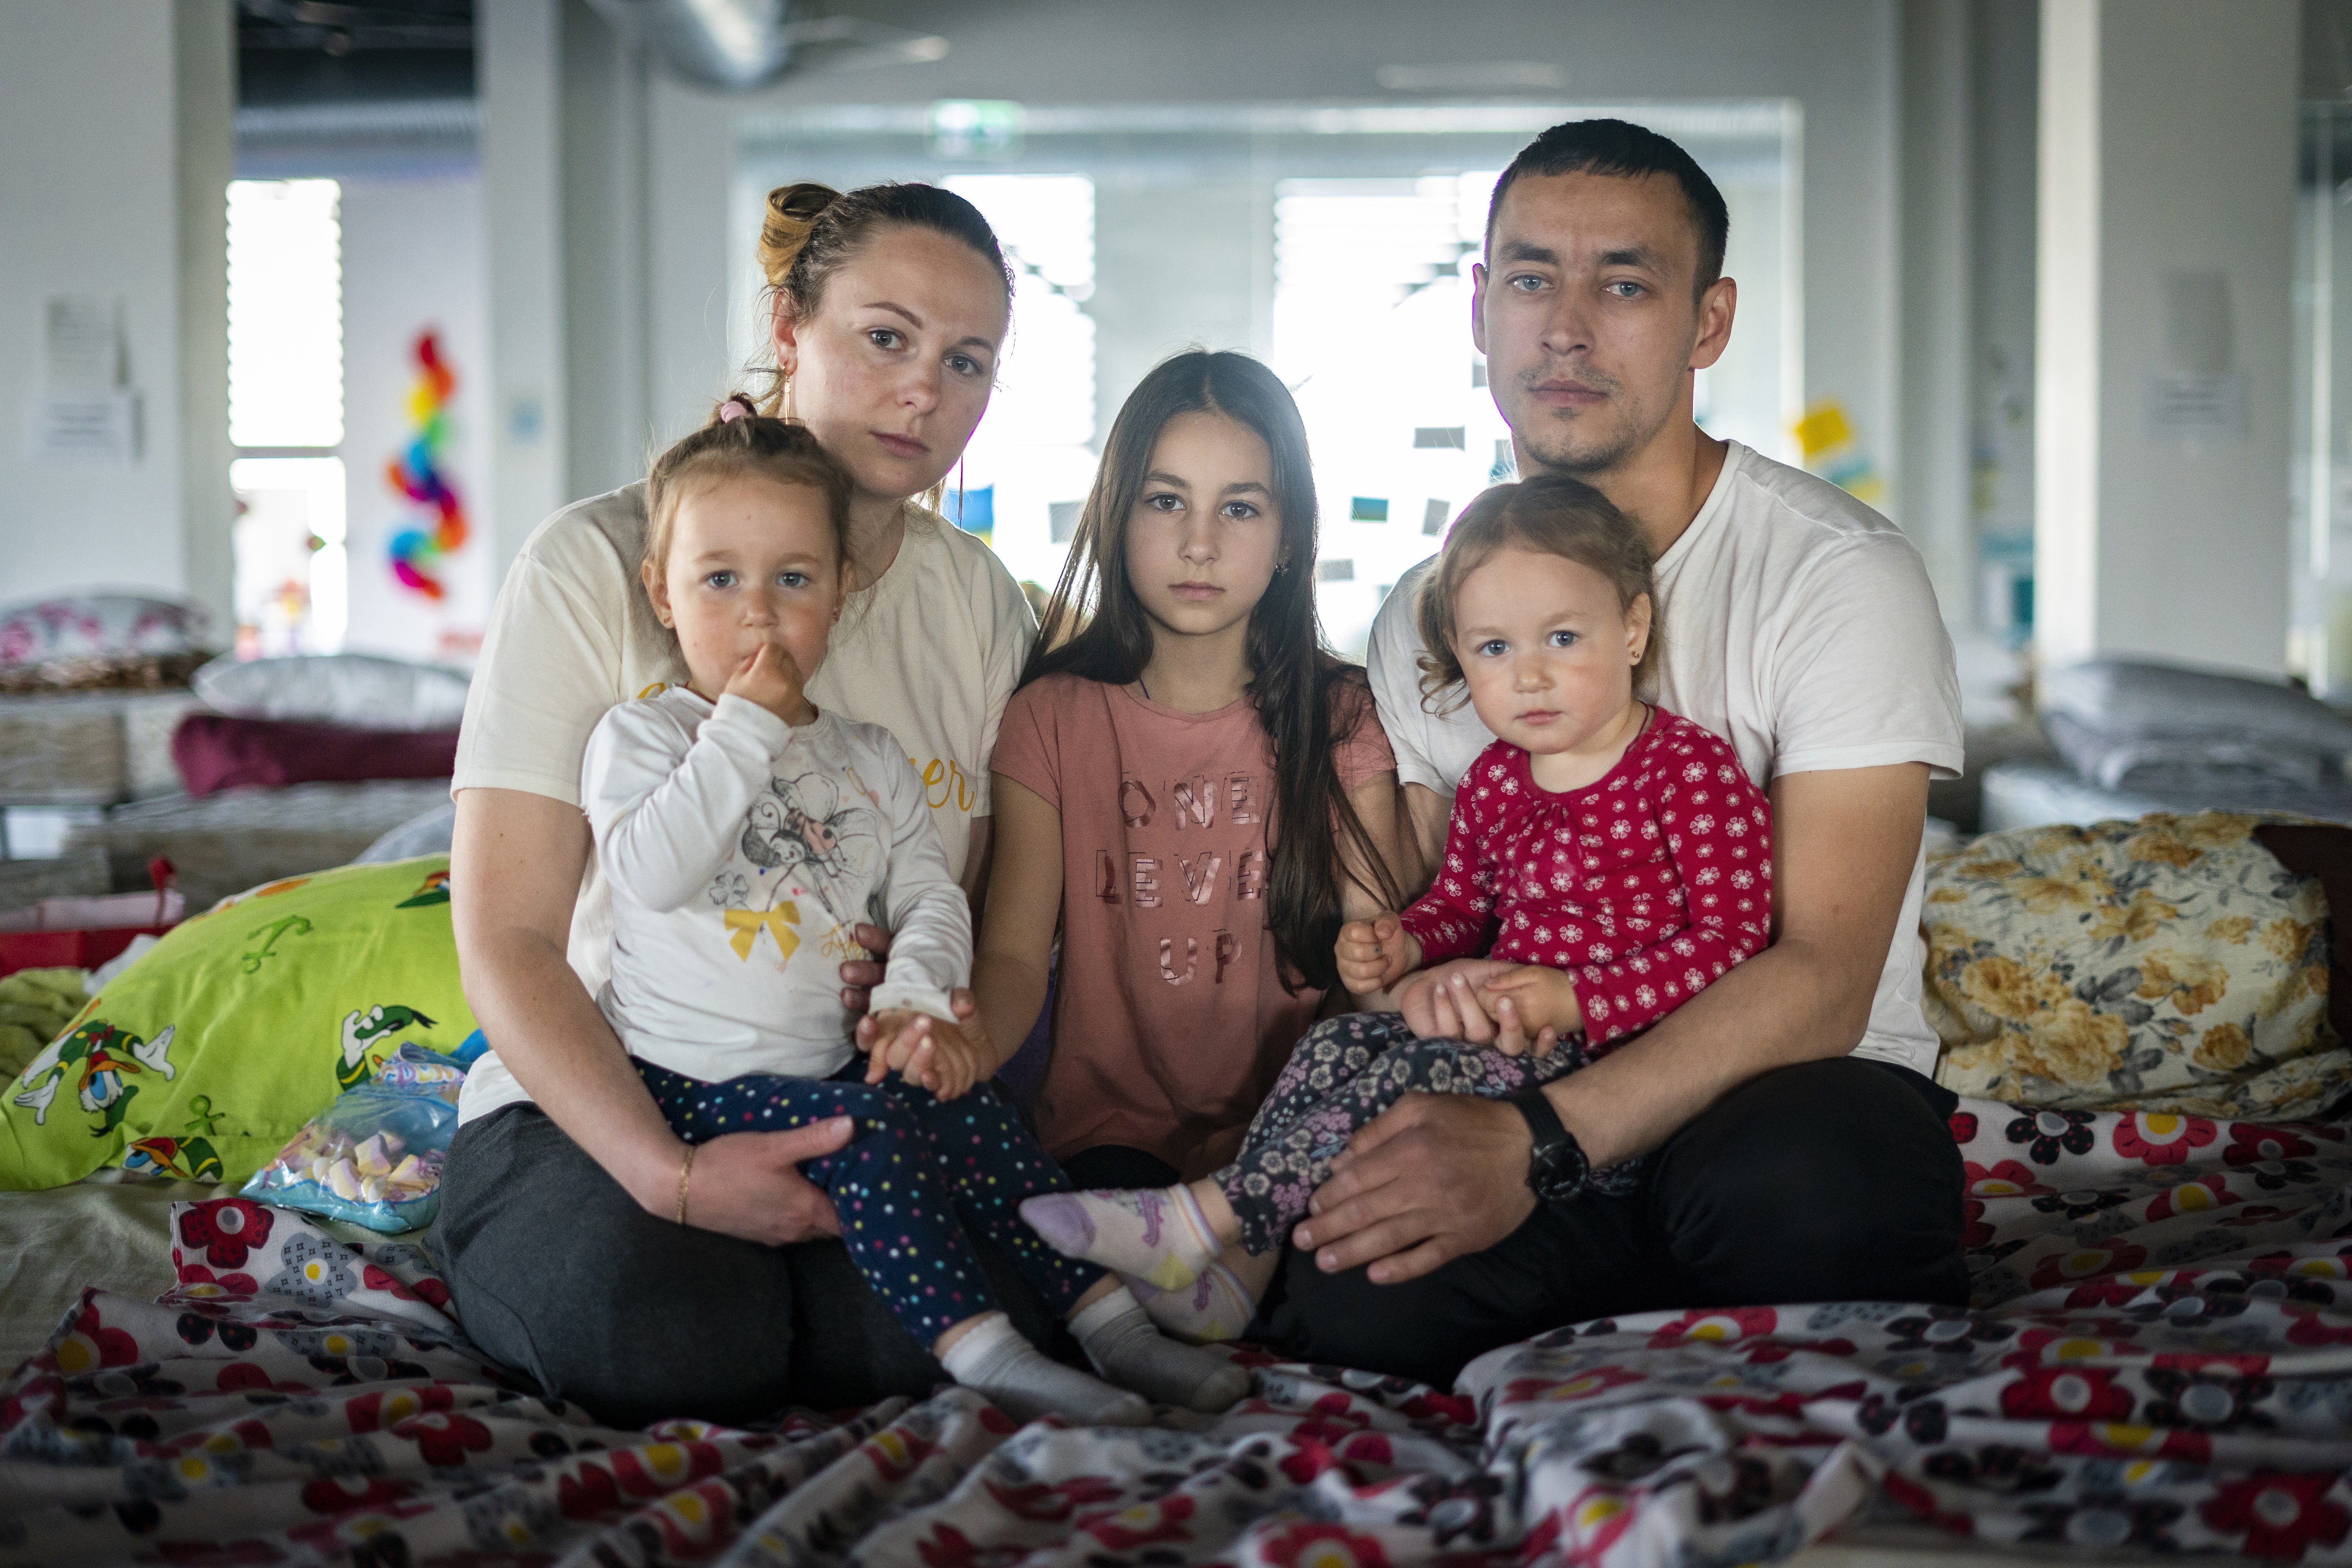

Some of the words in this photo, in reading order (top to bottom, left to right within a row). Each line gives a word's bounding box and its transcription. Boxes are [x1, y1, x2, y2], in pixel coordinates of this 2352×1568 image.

[909, 758, 975, 812] er
[1119, 772, 1261, 830] ONE
[1096, 849, 1268, 907] LEVE
[1160, 931, 1242, 986] UP
